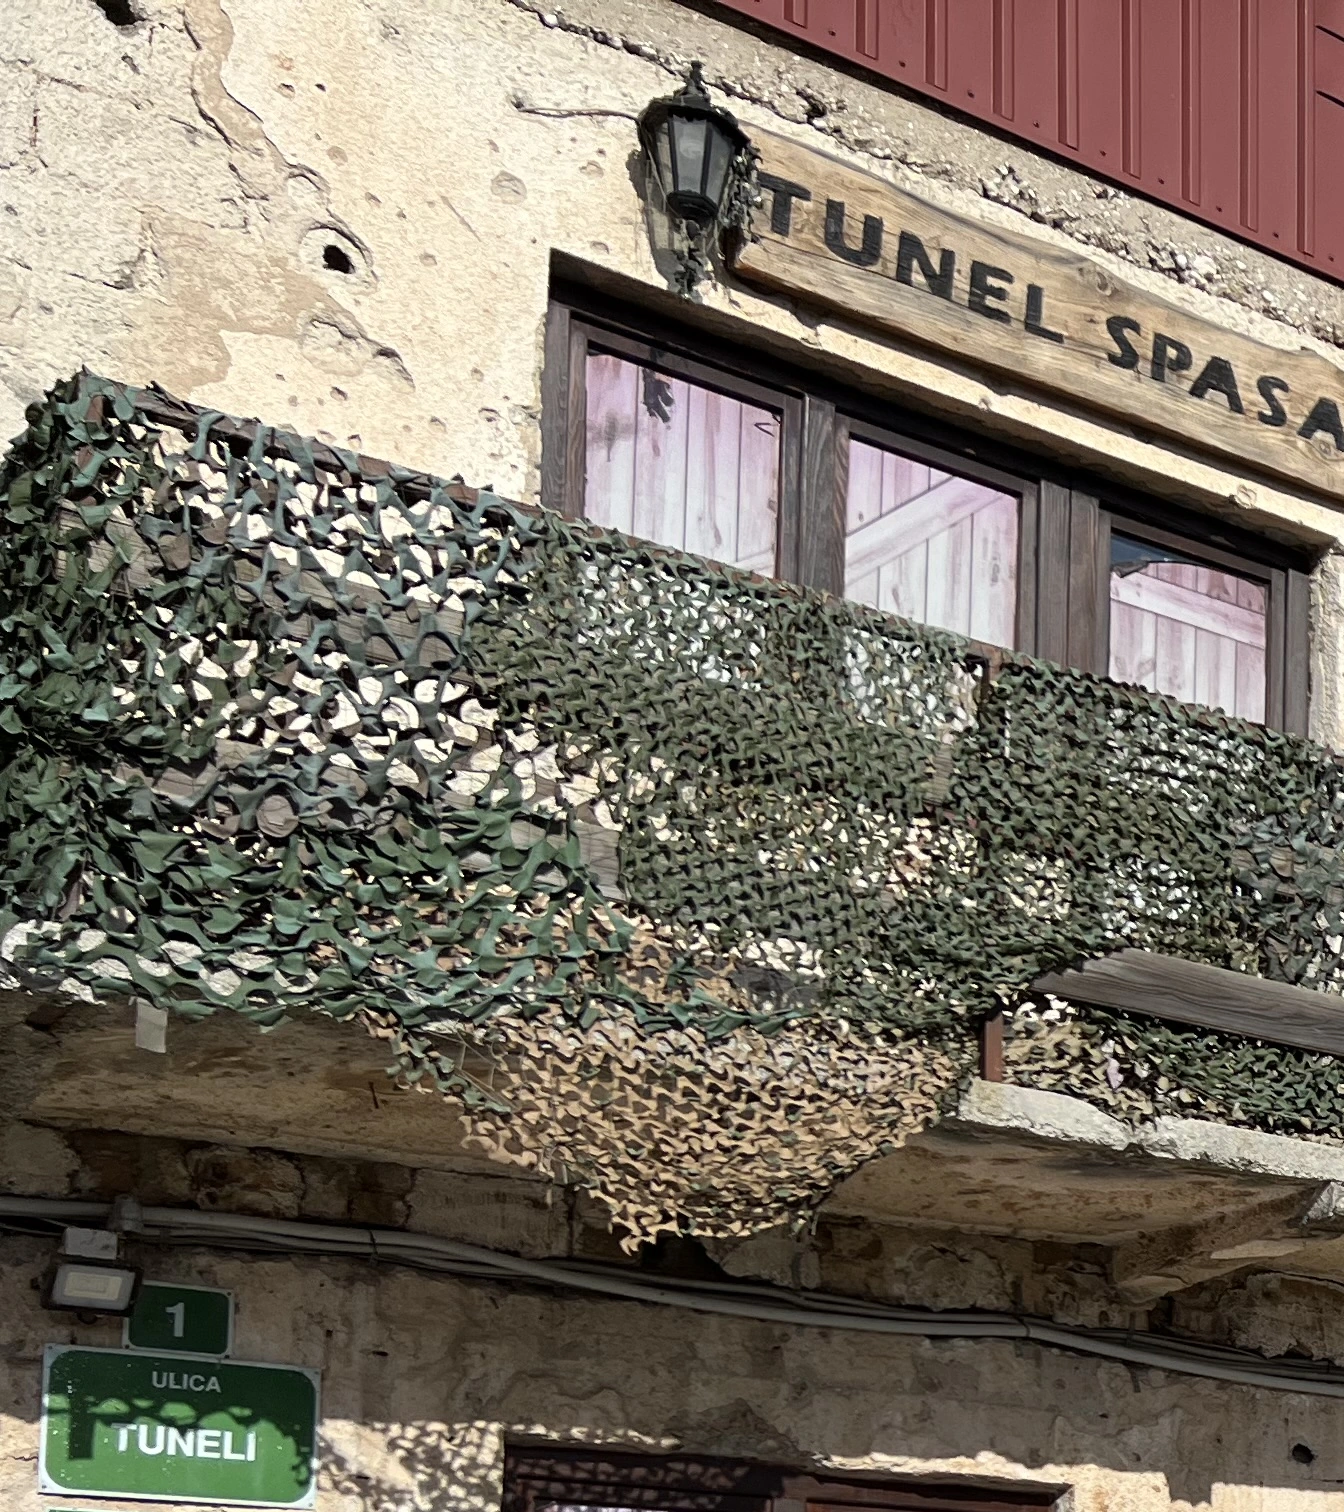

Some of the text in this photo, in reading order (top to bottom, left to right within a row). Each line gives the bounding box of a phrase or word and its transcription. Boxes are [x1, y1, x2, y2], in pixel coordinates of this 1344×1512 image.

[758, 170, 1066, 344] TUNEL
[165, 1302, 185, 1338] 1
[152, 1371, 222, 1393] ULICA
[112, 1423, 257, 1461] TUNELI
